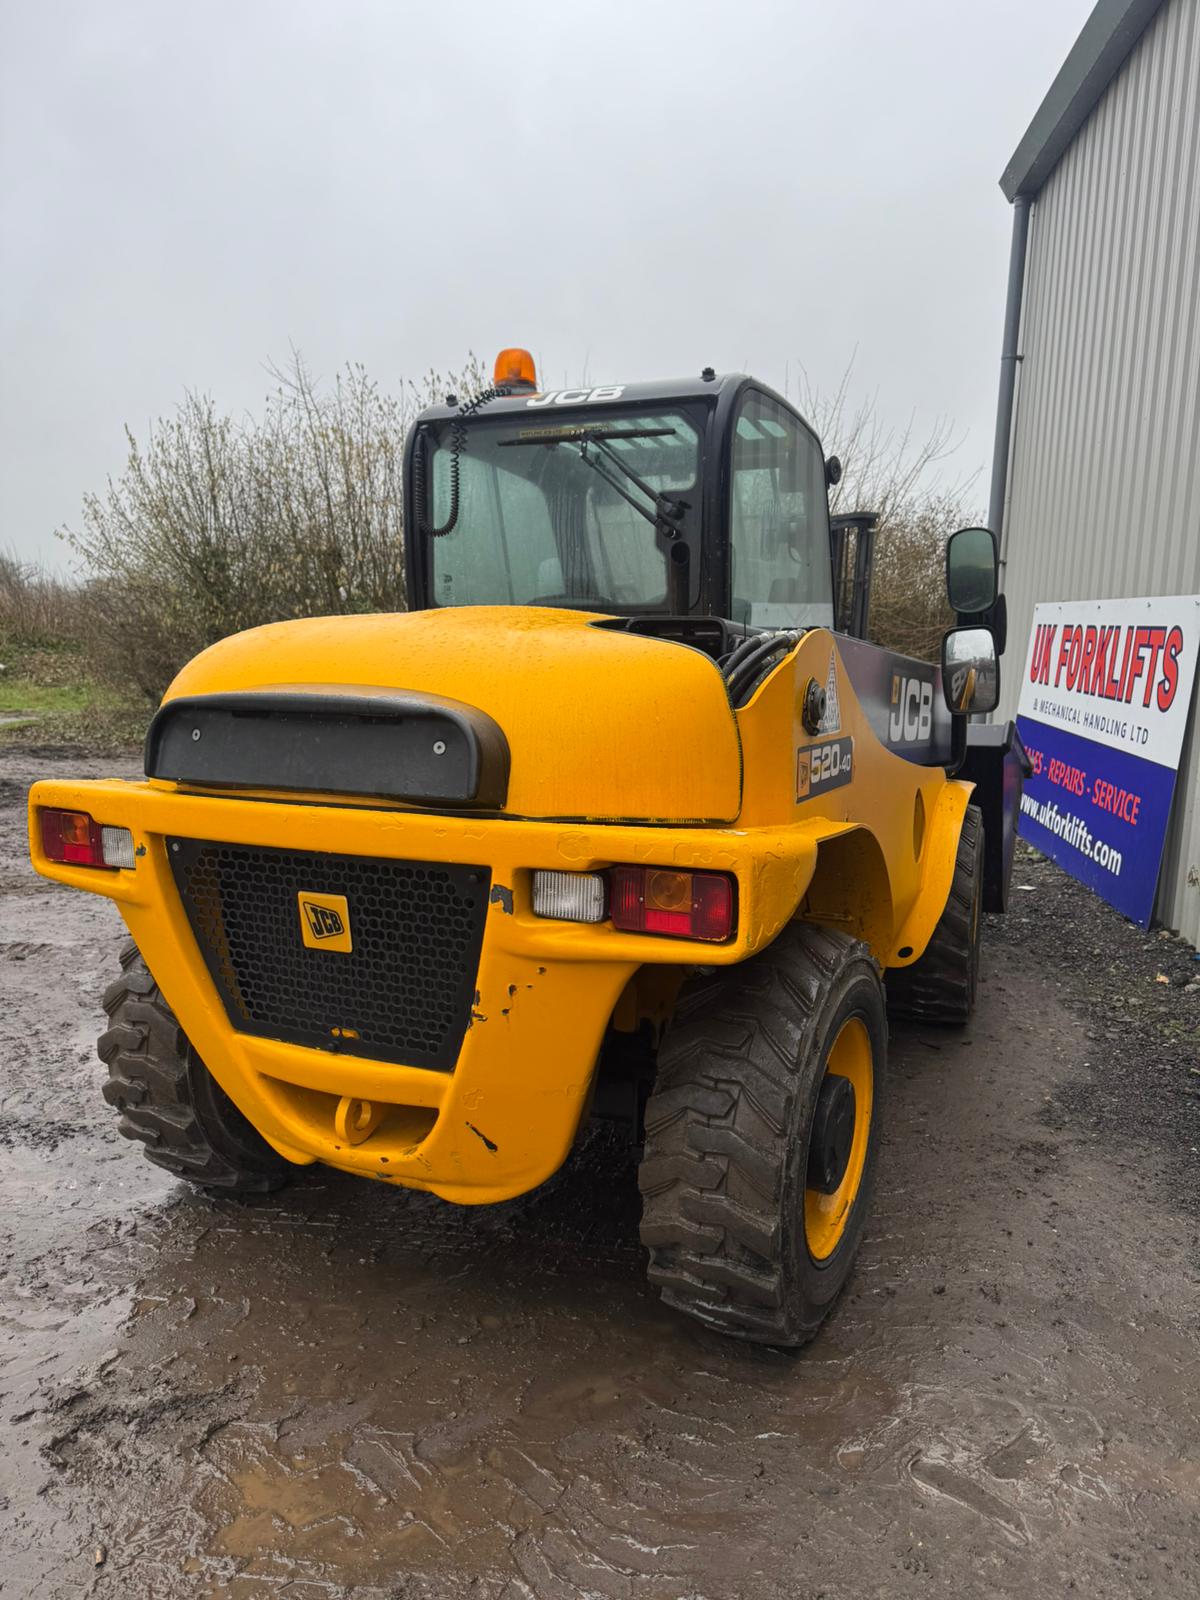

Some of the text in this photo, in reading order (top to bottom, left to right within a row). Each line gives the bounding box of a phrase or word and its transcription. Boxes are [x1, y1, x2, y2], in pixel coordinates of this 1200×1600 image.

[526, 385, 627, 407] JCB
[1030, 624, 1183, 712] UK FORKLIFTS
[890, 676, 933, 742] JCB
[1040, 700, 1081, 724] MECHANICAL
[1083, 713, 1127, 738] HANDLING
[1130, 725, 1149, 745] LTD
[1048, 758, 1086, 796] REPAIRS
[1091, 778, 1141, 826] SERVICE
[310, 906, 342, 935] JCB
